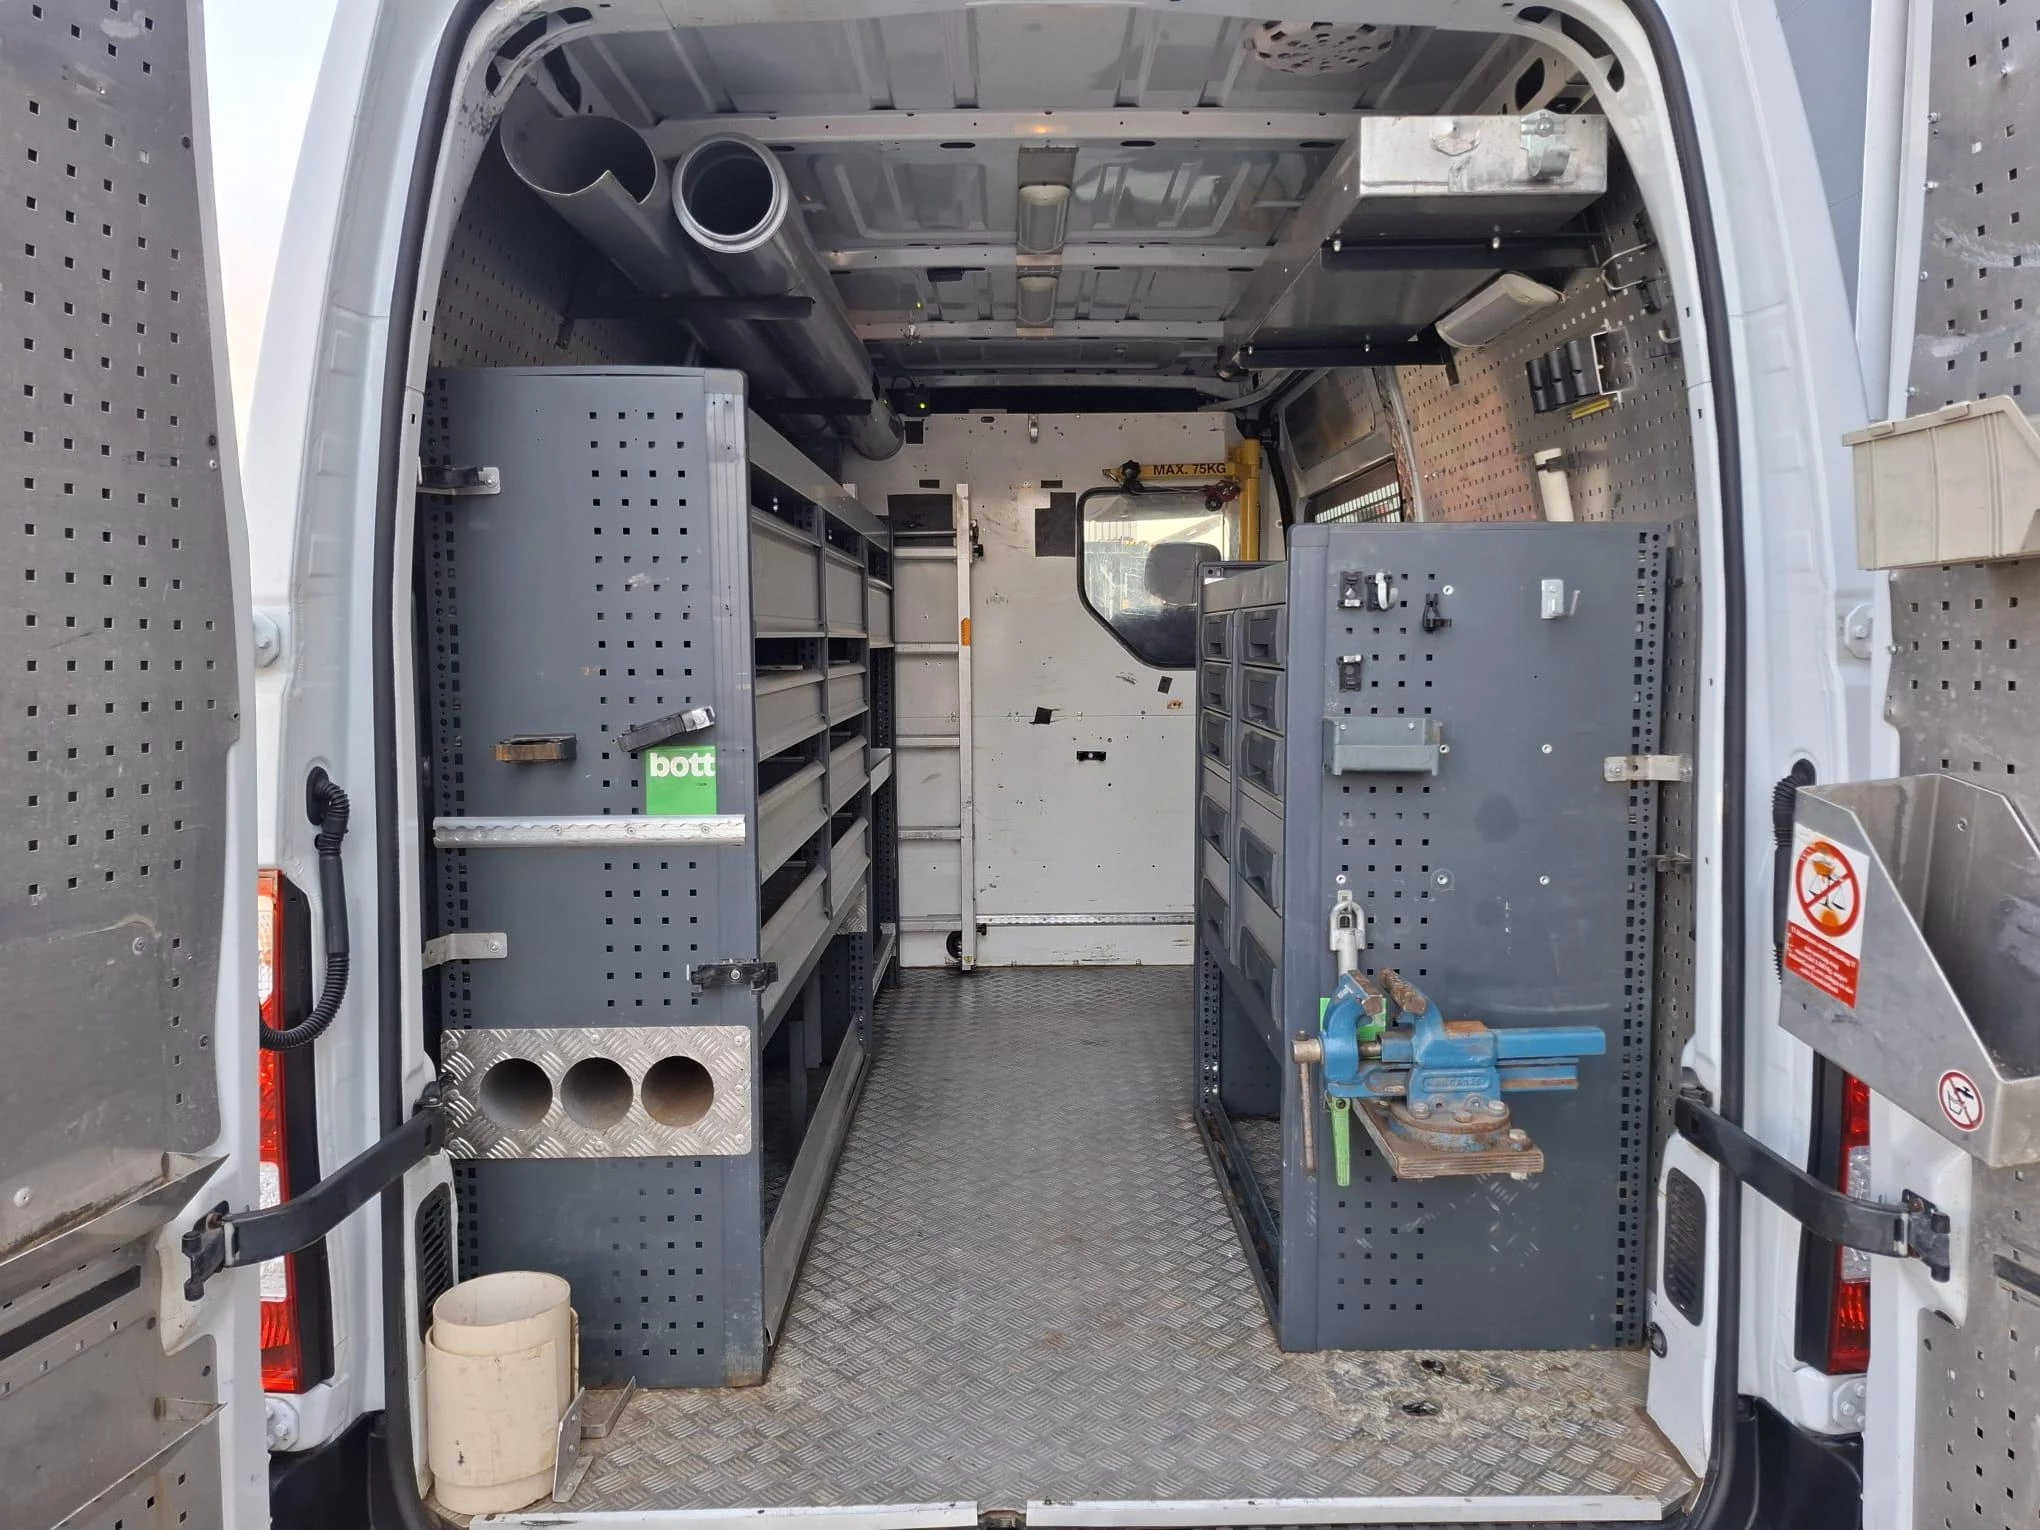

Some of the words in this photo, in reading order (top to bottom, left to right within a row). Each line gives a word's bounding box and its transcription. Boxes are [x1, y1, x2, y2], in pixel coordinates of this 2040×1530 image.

[1153, 463, 1189, 476] MAX.
[1192, 462, 1227, 475] 75KG
[649, 752, 716, 777] bott
